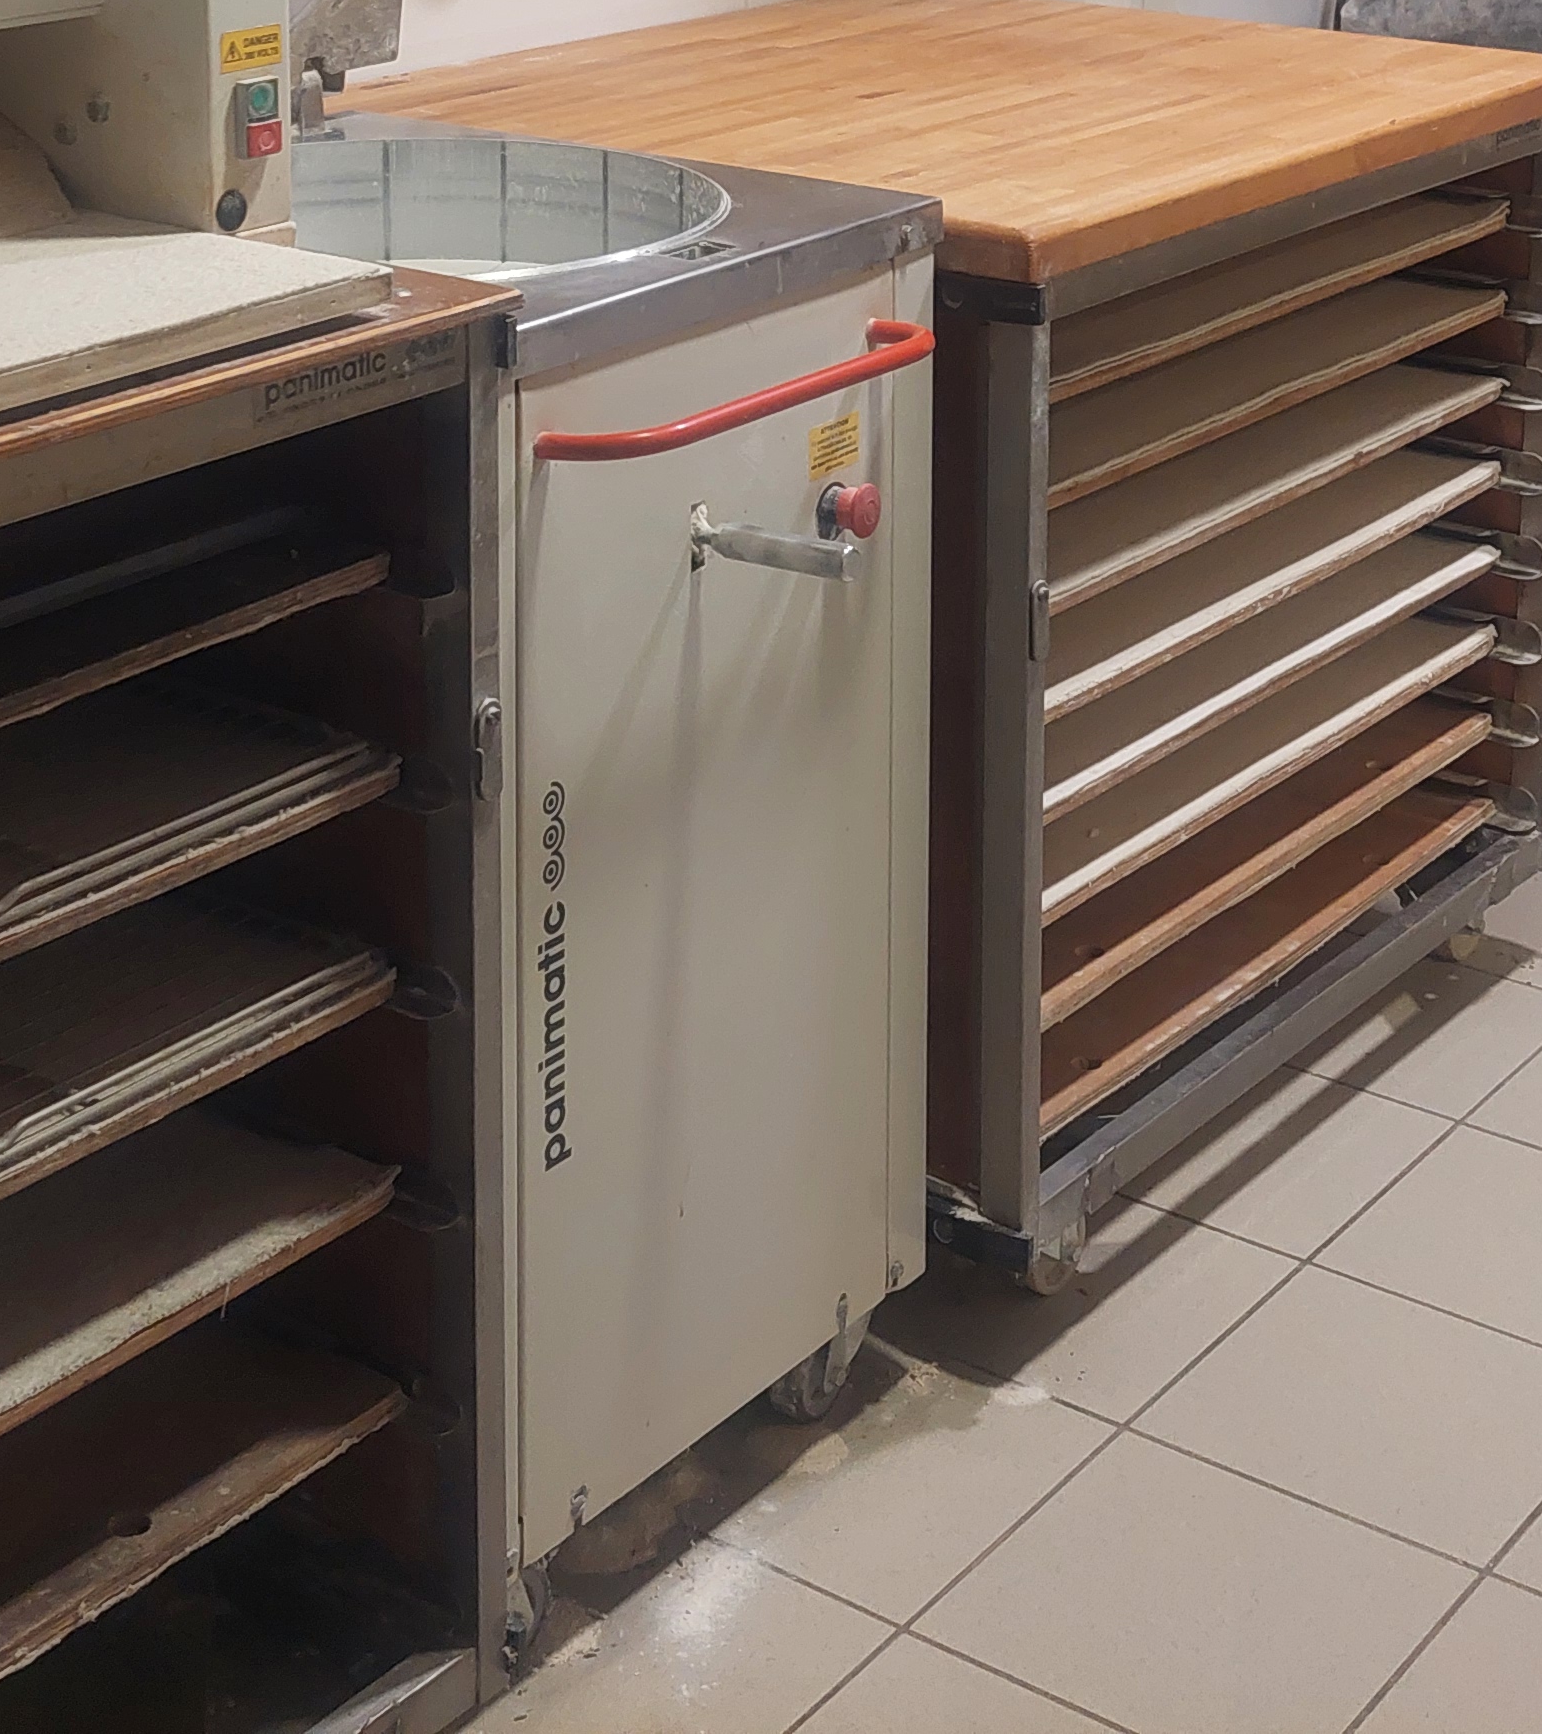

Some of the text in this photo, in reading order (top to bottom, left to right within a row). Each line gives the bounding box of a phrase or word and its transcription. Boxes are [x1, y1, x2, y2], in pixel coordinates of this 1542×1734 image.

[243, 32, 279, 48] DANGER
[264, 352, 387, 410] panimatic
[537, 901, 573, 1173] panimatic
